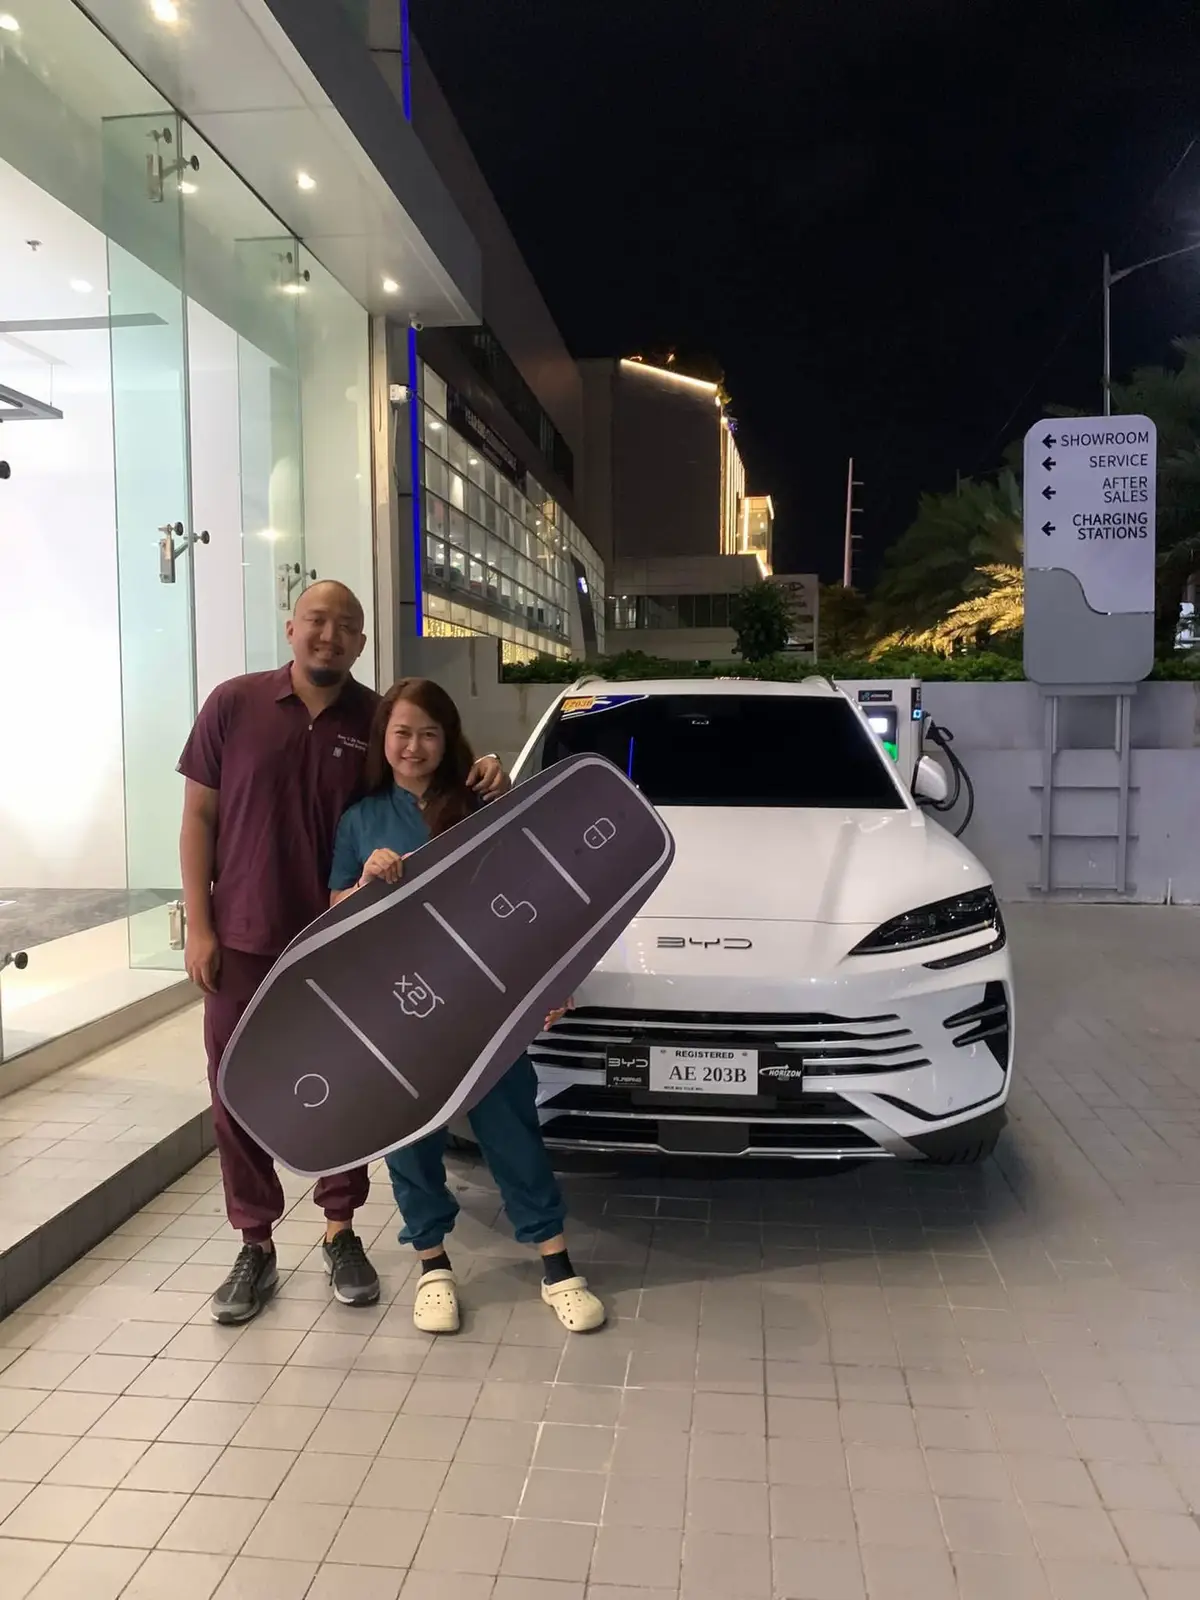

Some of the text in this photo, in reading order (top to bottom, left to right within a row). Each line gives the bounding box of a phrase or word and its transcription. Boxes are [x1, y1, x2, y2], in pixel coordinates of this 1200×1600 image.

[1060, 431, 1149, 447] SHOWROOM
[1089, 453, 1148, 468] SERVICE
[1102, 476, 1148, 490] AFTER
[1104, 489, 1148, 503] SALES
[1072, 512, 1148, 527] CHARGING
[1077, 526, 1148, 540] STATIONS
[657, 936, 752, 949] BYD
[675, 1050, 735, 1060] REGISTERED
[607, 1057, 649, 1068] BYD
[668, 1065, 747, 1083] AE 203B
[768, 1069, 802, 1078] HORIZON
